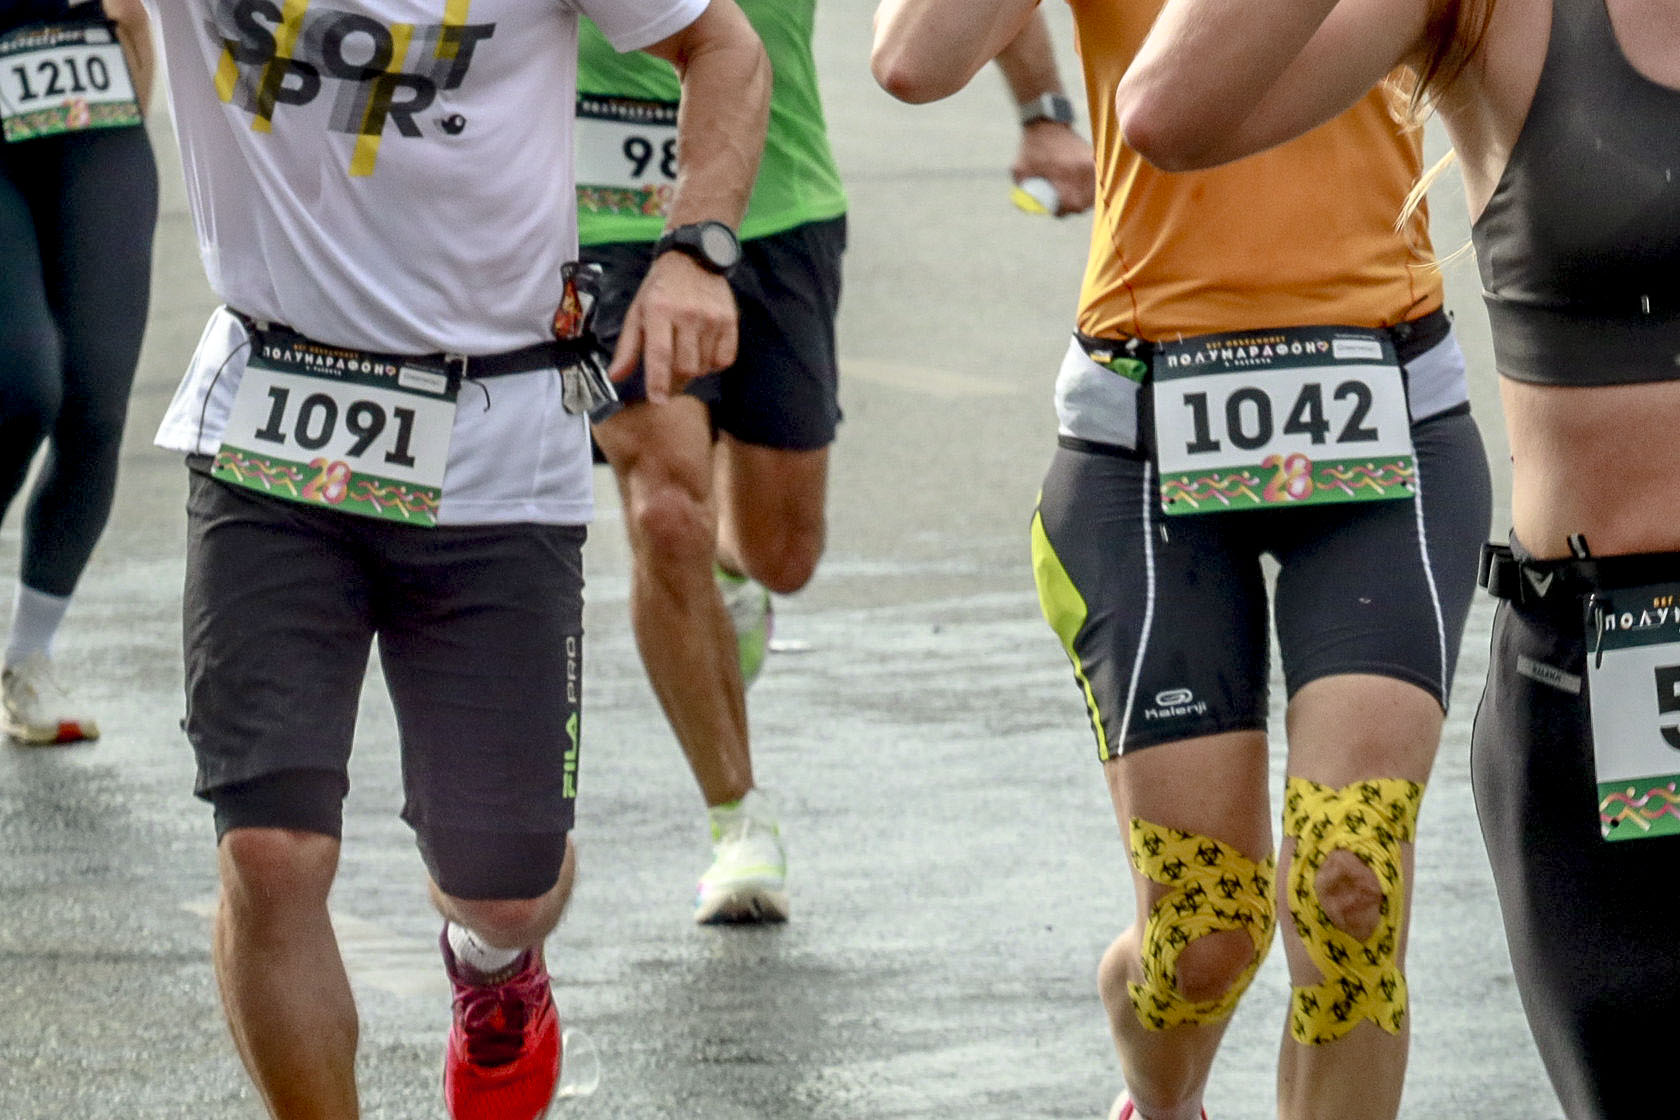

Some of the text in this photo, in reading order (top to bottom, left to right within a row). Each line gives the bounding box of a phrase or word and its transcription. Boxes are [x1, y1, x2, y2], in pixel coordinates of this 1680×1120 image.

[11, 56, 111, 102] 1210
[1167, 340, 1317, 368] ПОЛУМАРАФОН
[254, 385, 416, 468] 1091
[1183, 380, 1380, 455] 1042
[301, 456, 352, 505] 28
[1260, 452, 1314, 503] 28
[562, 636, 577, 799] FILA PRO
